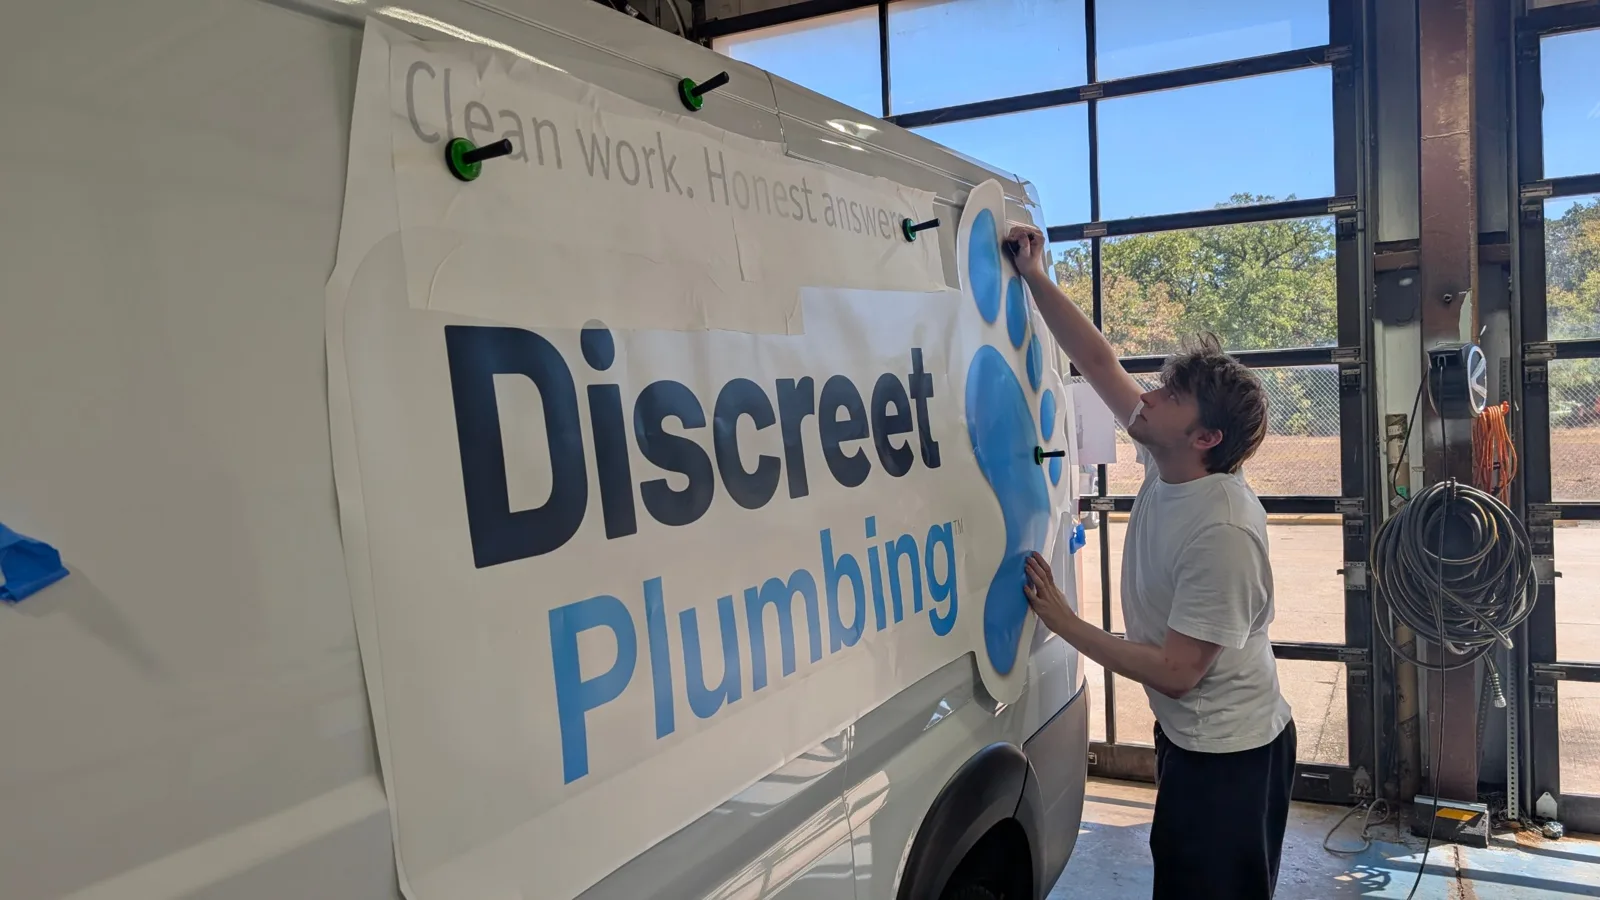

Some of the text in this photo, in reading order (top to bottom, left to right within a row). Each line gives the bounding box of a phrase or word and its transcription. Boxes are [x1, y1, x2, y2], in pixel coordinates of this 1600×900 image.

[406, 60, 562, 170] Clean
[575, 128, 694, 199] work.
[704, 146, 818, 223] Honest
[444, 319, 941, 568] Discreet
